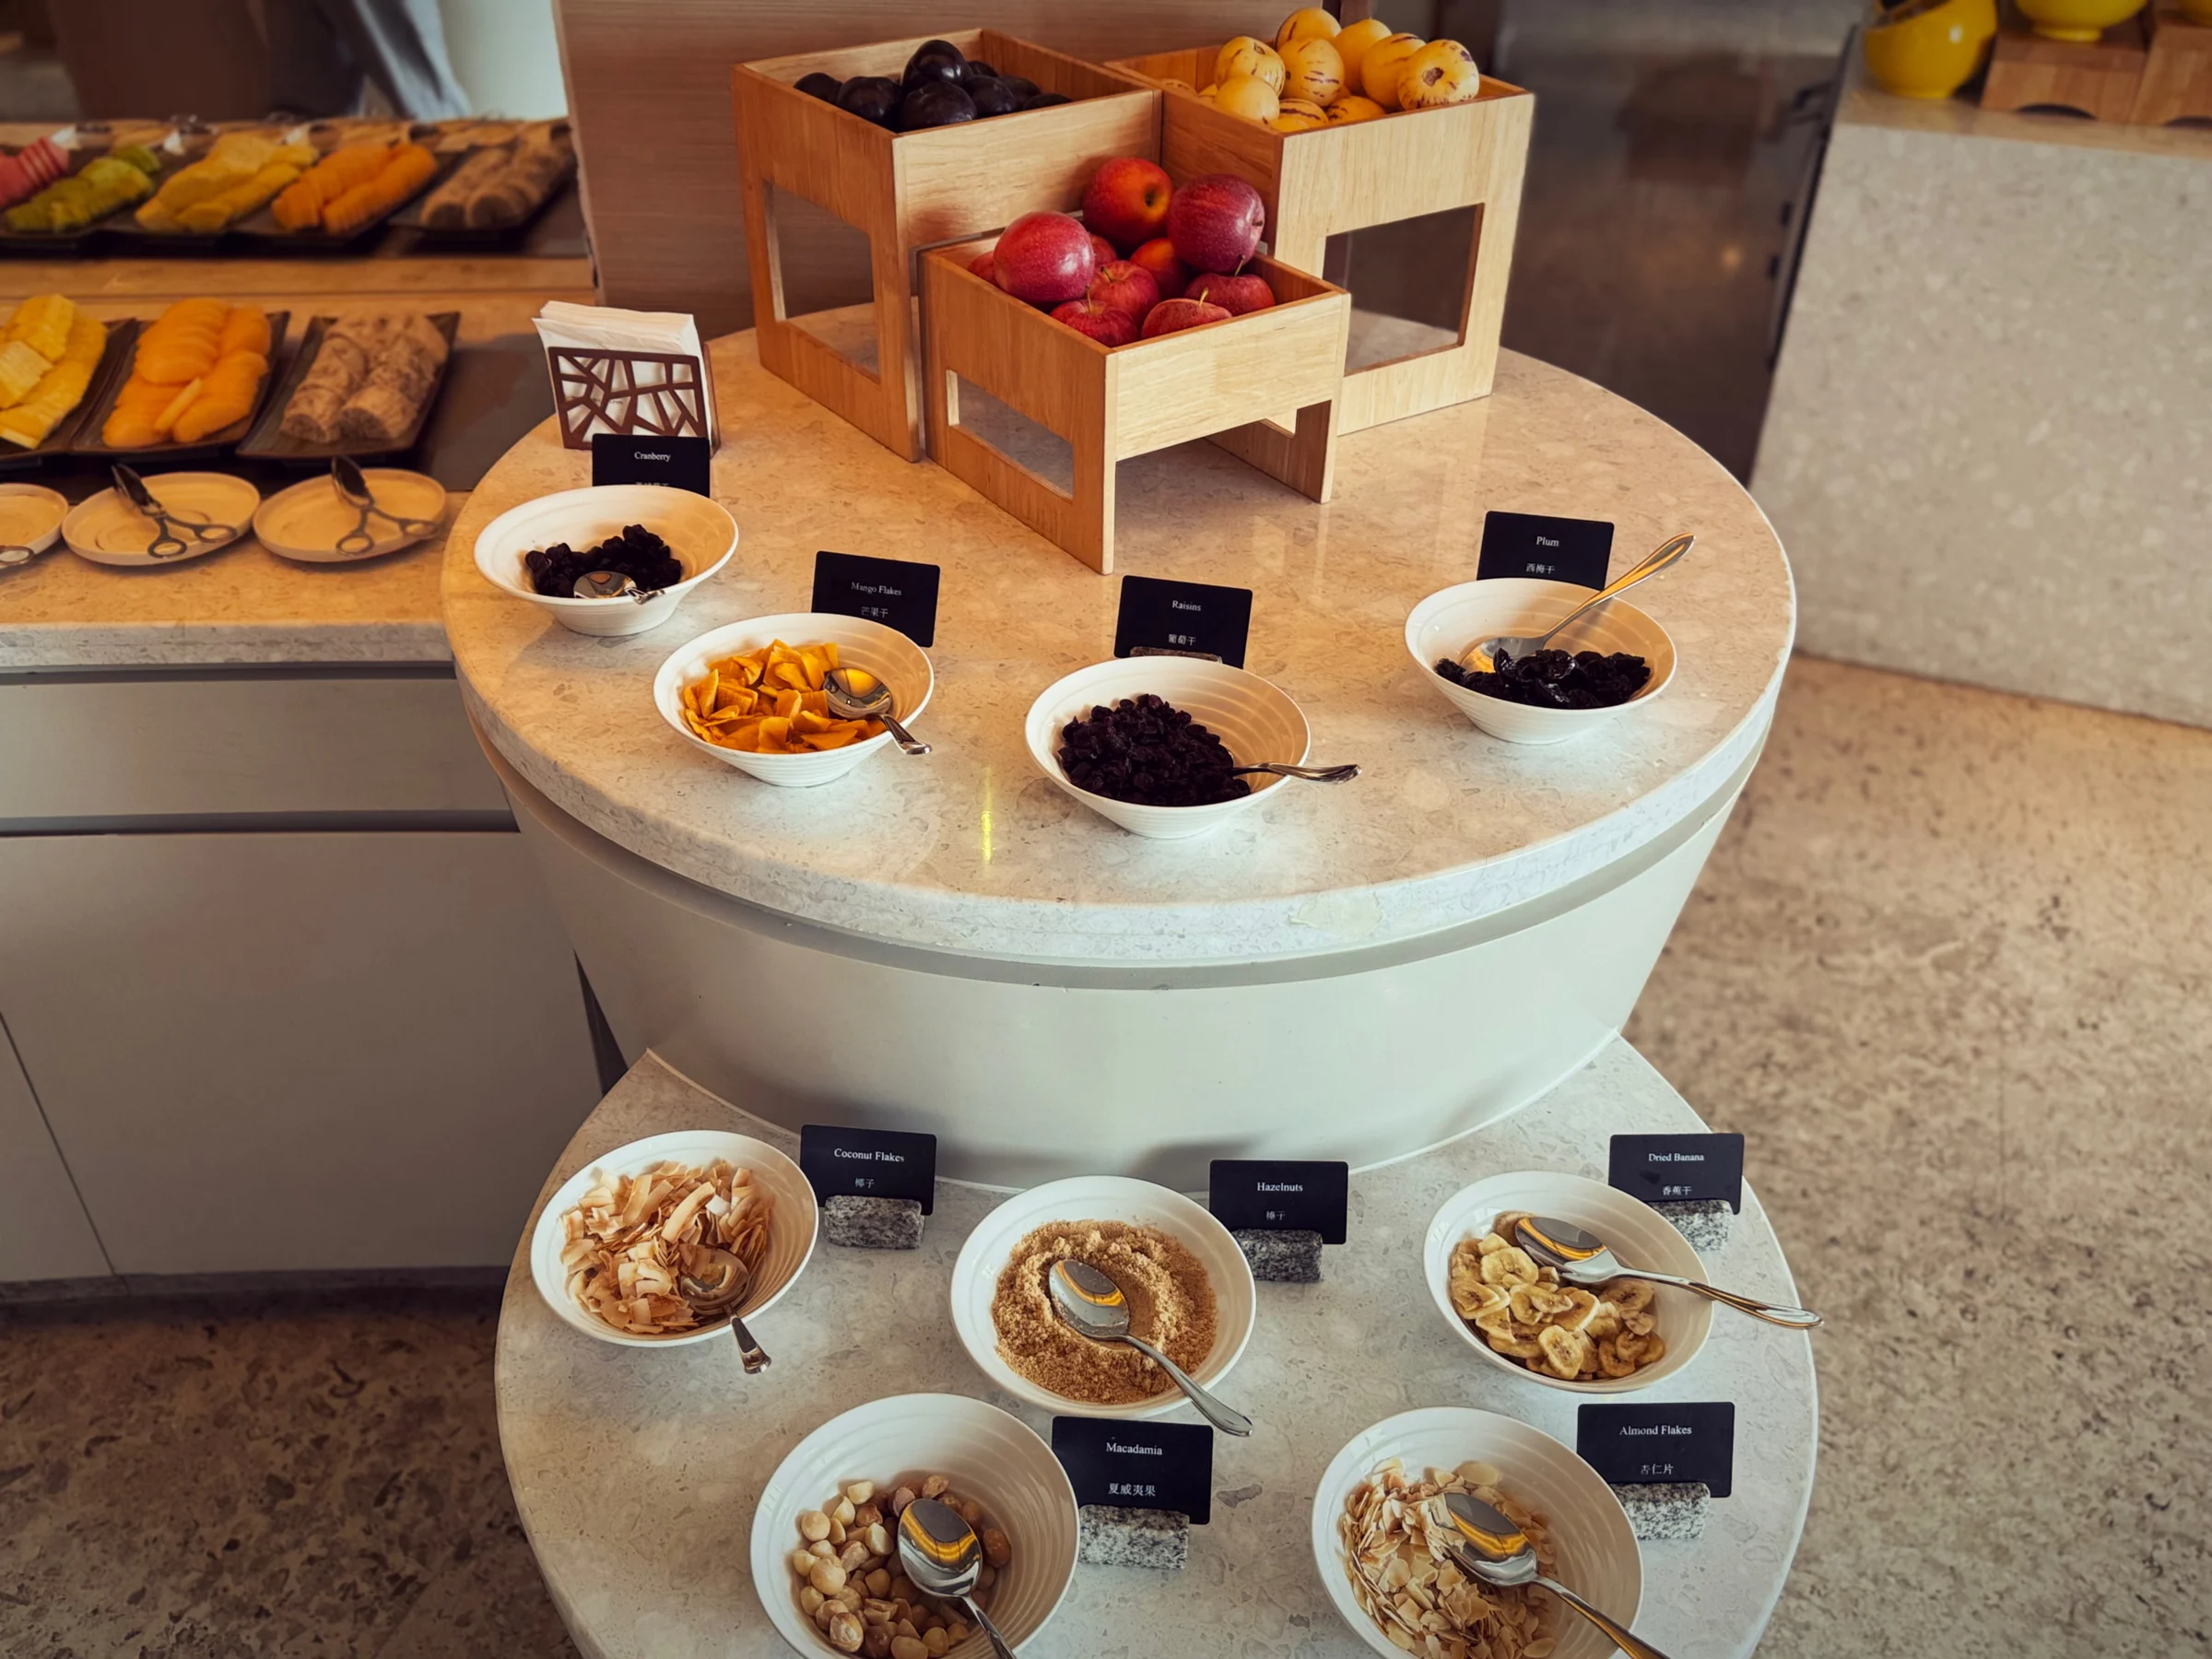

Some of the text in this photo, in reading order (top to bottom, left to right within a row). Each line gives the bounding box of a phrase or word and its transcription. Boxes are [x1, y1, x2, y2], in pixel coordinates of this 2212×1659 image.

[634, 452, 671, 463] Cranberry
[1536, 535, 1559, 547] Plum
[1526, 562, 1555, 574] 西梅干
[851, 582, 902, 595] Mango Flakes
[861, 606, 888, 618] 芒果干
[1172, 600, 1202, 612] Raisins
[1168, 633, 1196, 646] 葡萄干
[834, 1147, 905, 1162] Coconut Flakes
[1648, 1153, 1704, 1161] Dried Banana
[1257, 1182, 1303, 1192] Hazelnuts
[1663, 1185, 1692, 1195] 香蕉干
[1619, 1425, 1692, 1436] Almond Flakes
[1106, 1442, 1163, 1455] Macadamia
[1641, 1463, 1674, 1476] 杏仁片
[1108, 1482, 1157, 1497] 夏威夷果
